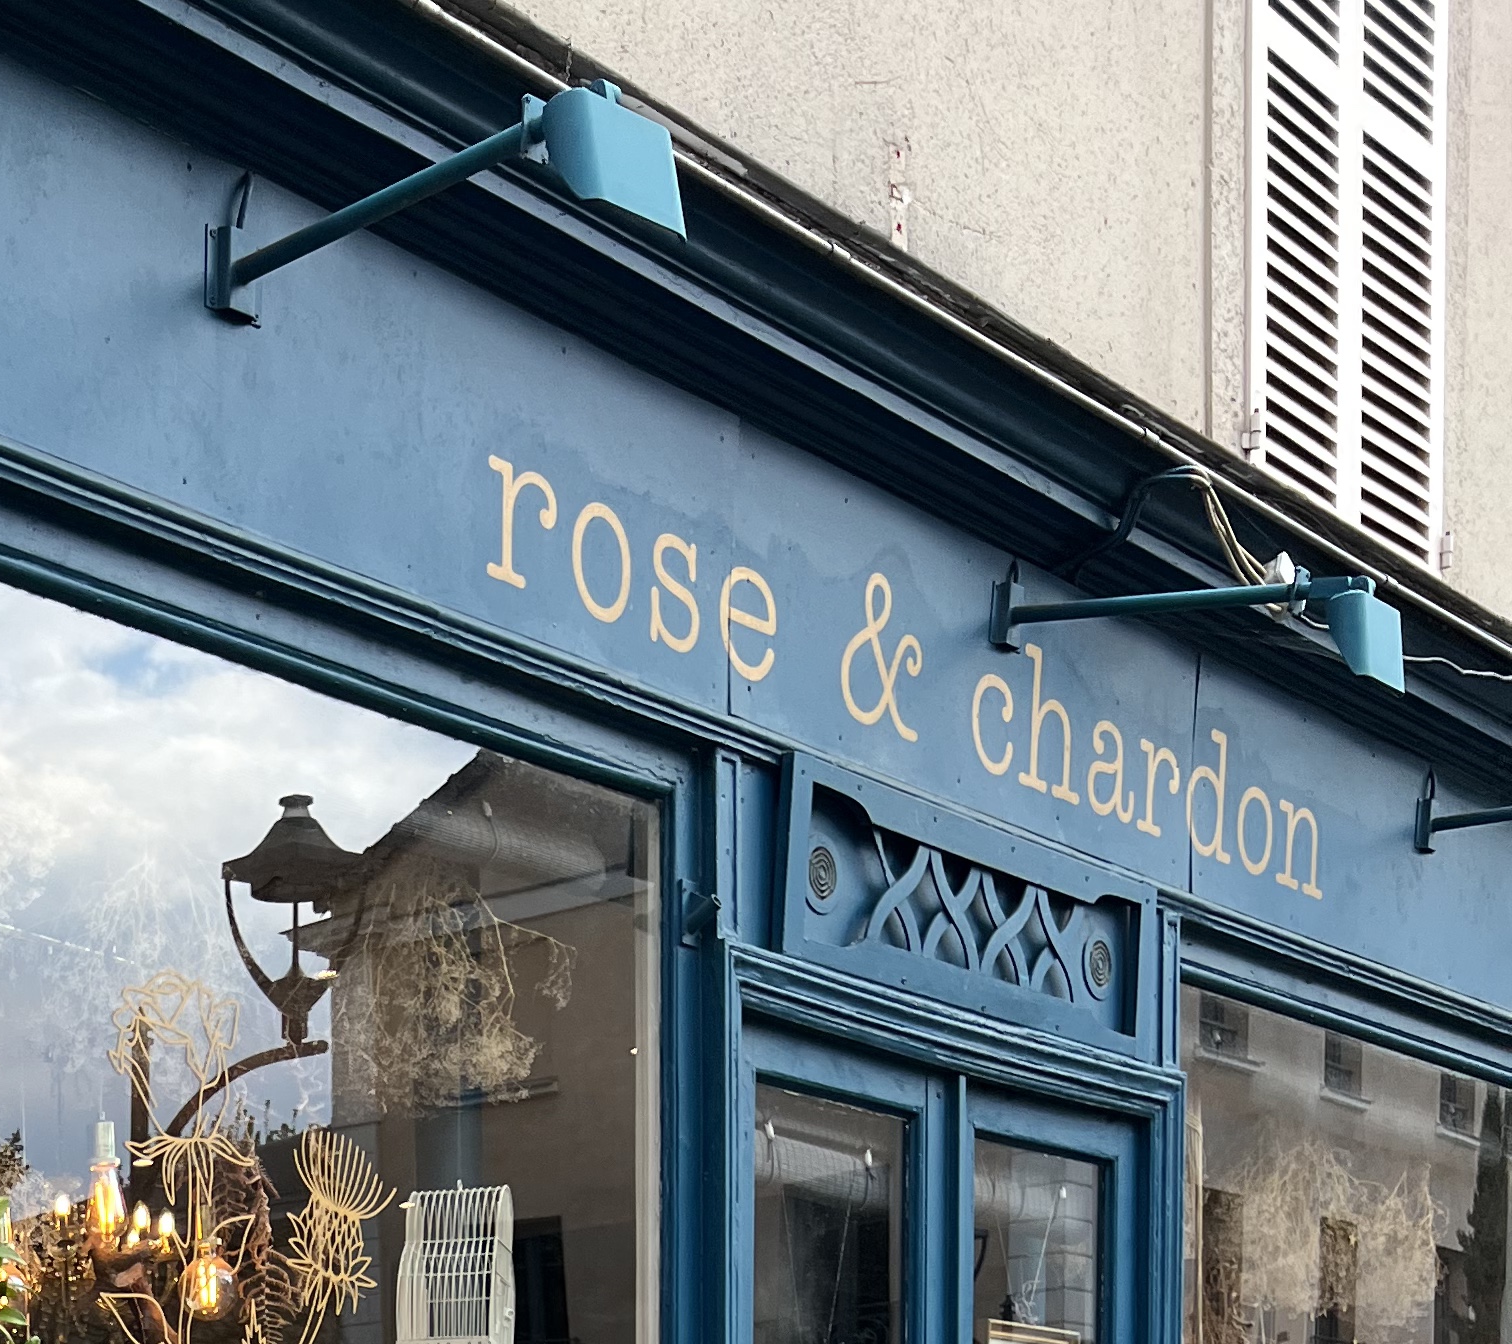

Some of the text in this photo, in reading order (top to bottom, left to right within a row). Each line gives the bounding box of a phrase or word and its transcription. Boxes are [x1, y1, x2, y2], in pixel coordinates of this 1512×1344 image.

[487, 454, 1323, 901] rose & chardon
